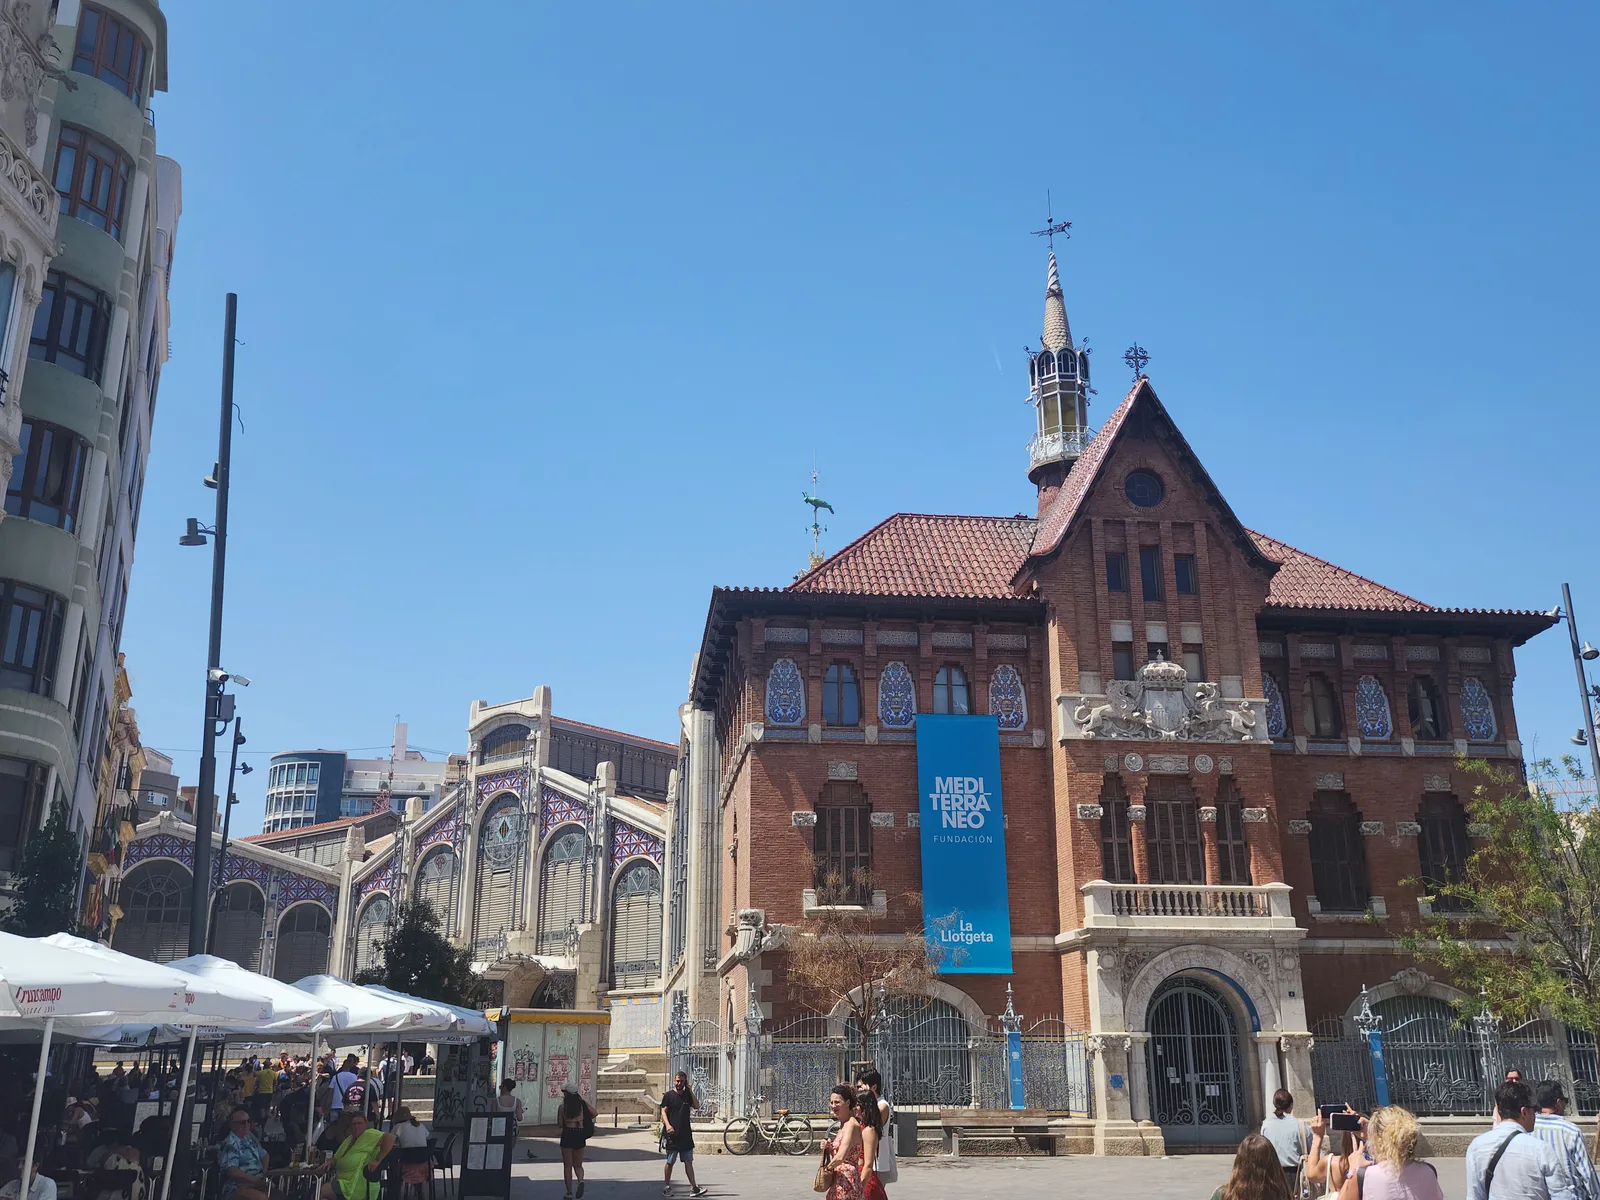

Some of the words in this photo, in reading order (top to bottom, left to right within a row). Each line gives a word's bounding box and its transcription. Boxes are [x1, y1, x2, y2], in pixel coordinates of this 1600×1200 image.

[942, 810, 985, 829] NEO
[933, 834, 993, 843] FUNDACIÓN
[960, 920, 973, 931] La
[941, 930, 994, 945] Llotgeta
[15, 986, 62, 1004] Cruzcampo
